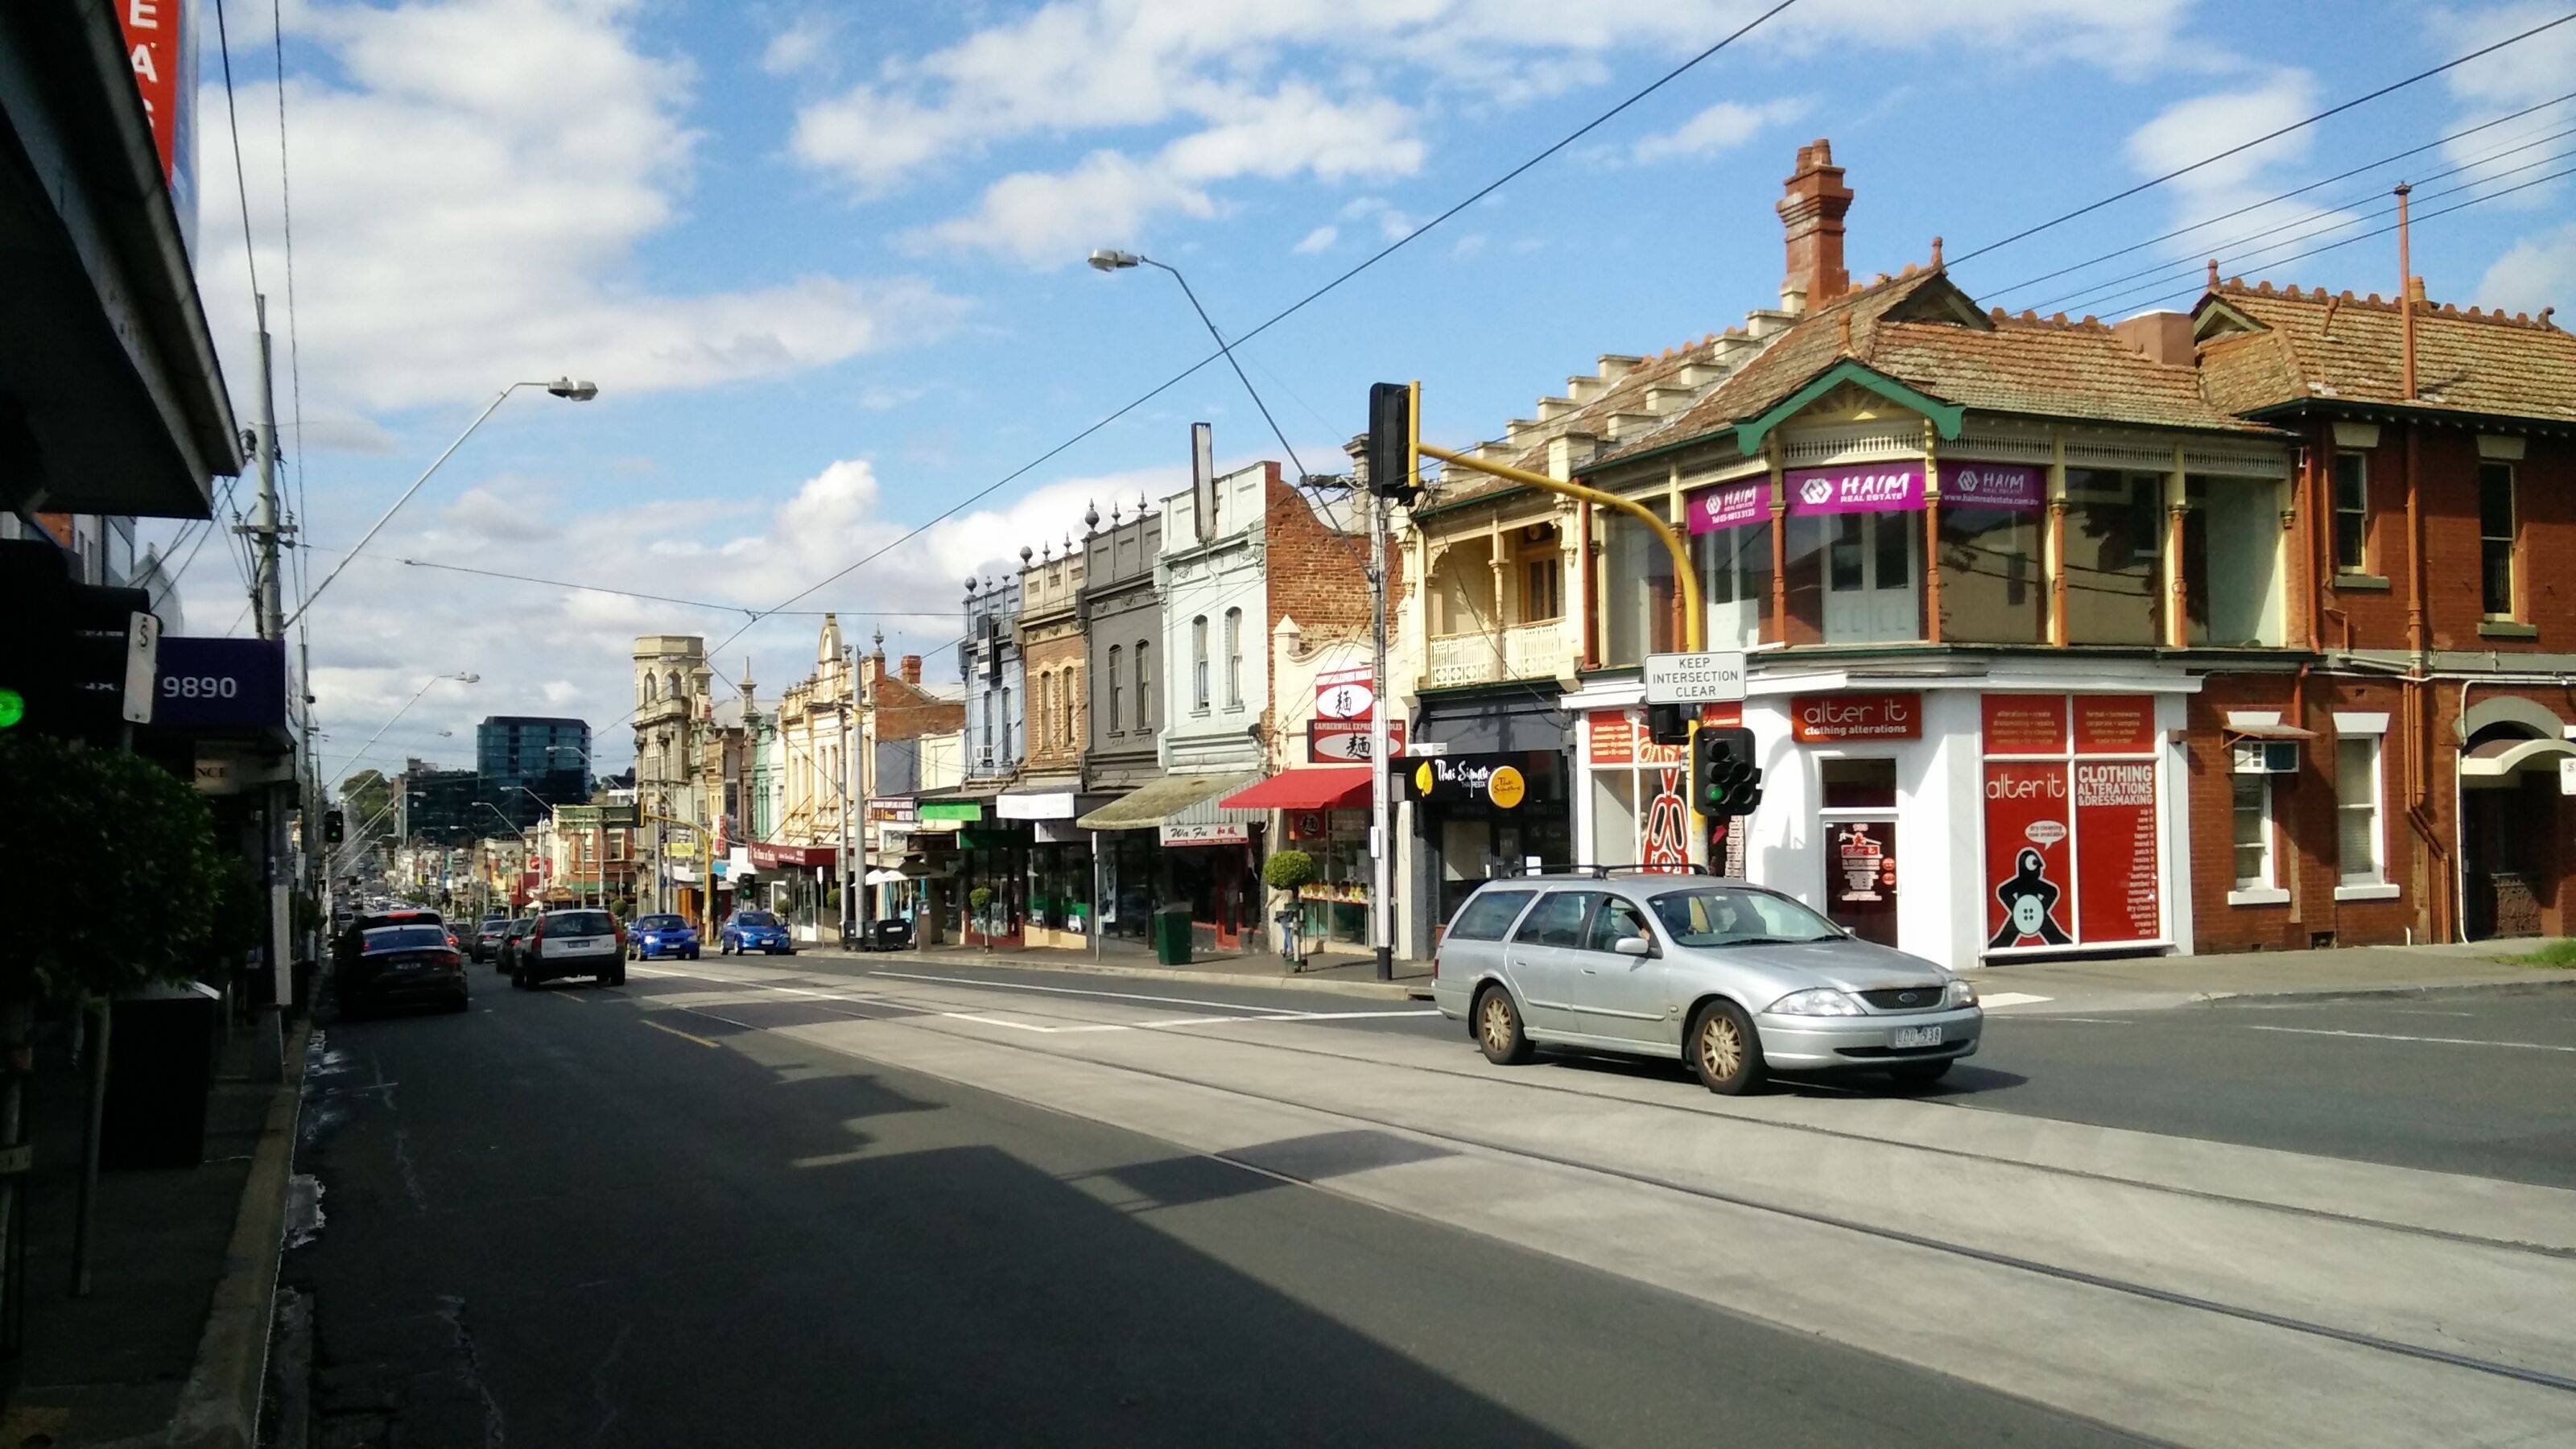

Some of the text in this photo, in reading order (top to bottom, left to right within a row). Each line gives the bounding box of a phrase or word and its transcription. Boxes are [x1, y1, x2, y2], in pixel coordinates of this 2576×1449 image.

[1841, 473, 1909, 497] HAIM
[1984, 473, 2025, 492] HAIM
[1724, 486, 1756, 504] HAIM
[1841, 493, 1902, 502] REAL ESTATE
[1679, 658, 1710, 668] KEEP
[1653, 671, 1738, 683] INTERSECTION
[163, 676, 237, 698] 9890
[1676, 686, 1715, 697] CLEAR
[1804, 699, 1906, 724] alter it
[1805, 724, 1907, 736] clothing alterations
[1435, 759, 1456, 782] Thai
[2079, 766, 2153, 783] CLOTHING
[1986, 773, 2066, 799] alter it
[2078, 782, 2153, 795] ALTERATIONS
[2078, 795, 2153, 806] &DRESSMAKING
[1170, 827, 1208, 838] Wa Fu
